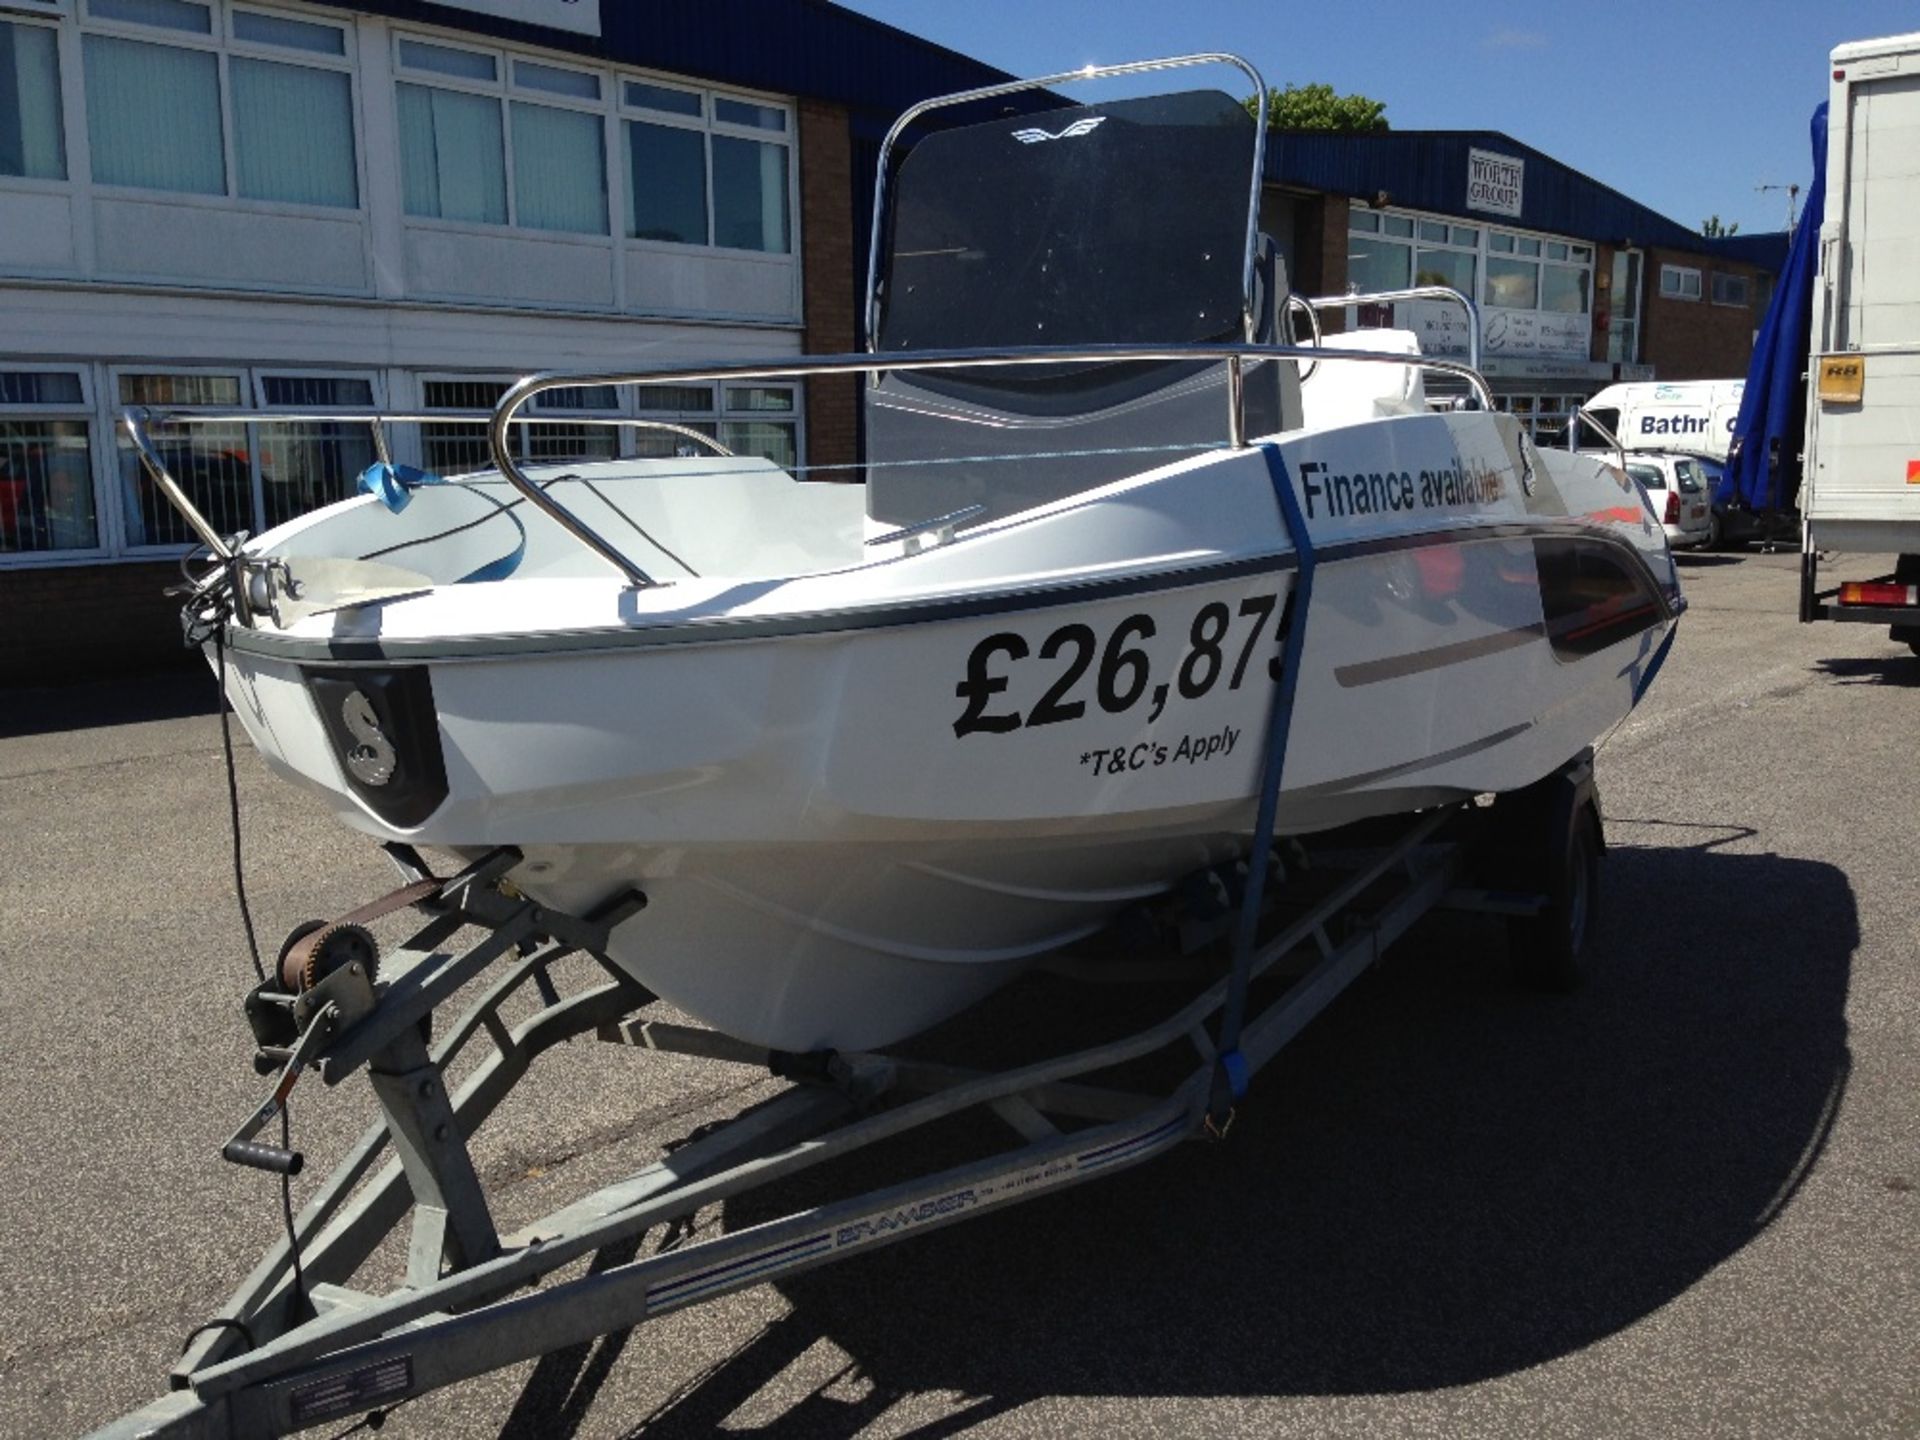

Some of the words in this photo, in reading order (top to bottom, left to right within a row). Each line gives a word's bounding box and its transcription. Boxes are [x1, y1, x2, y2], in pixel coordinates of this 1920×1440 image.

[1300, 462, 1414, 519] Finance
[1419, 456, 1500, 508] available
[1172, 725, 1241, 764] Apply
